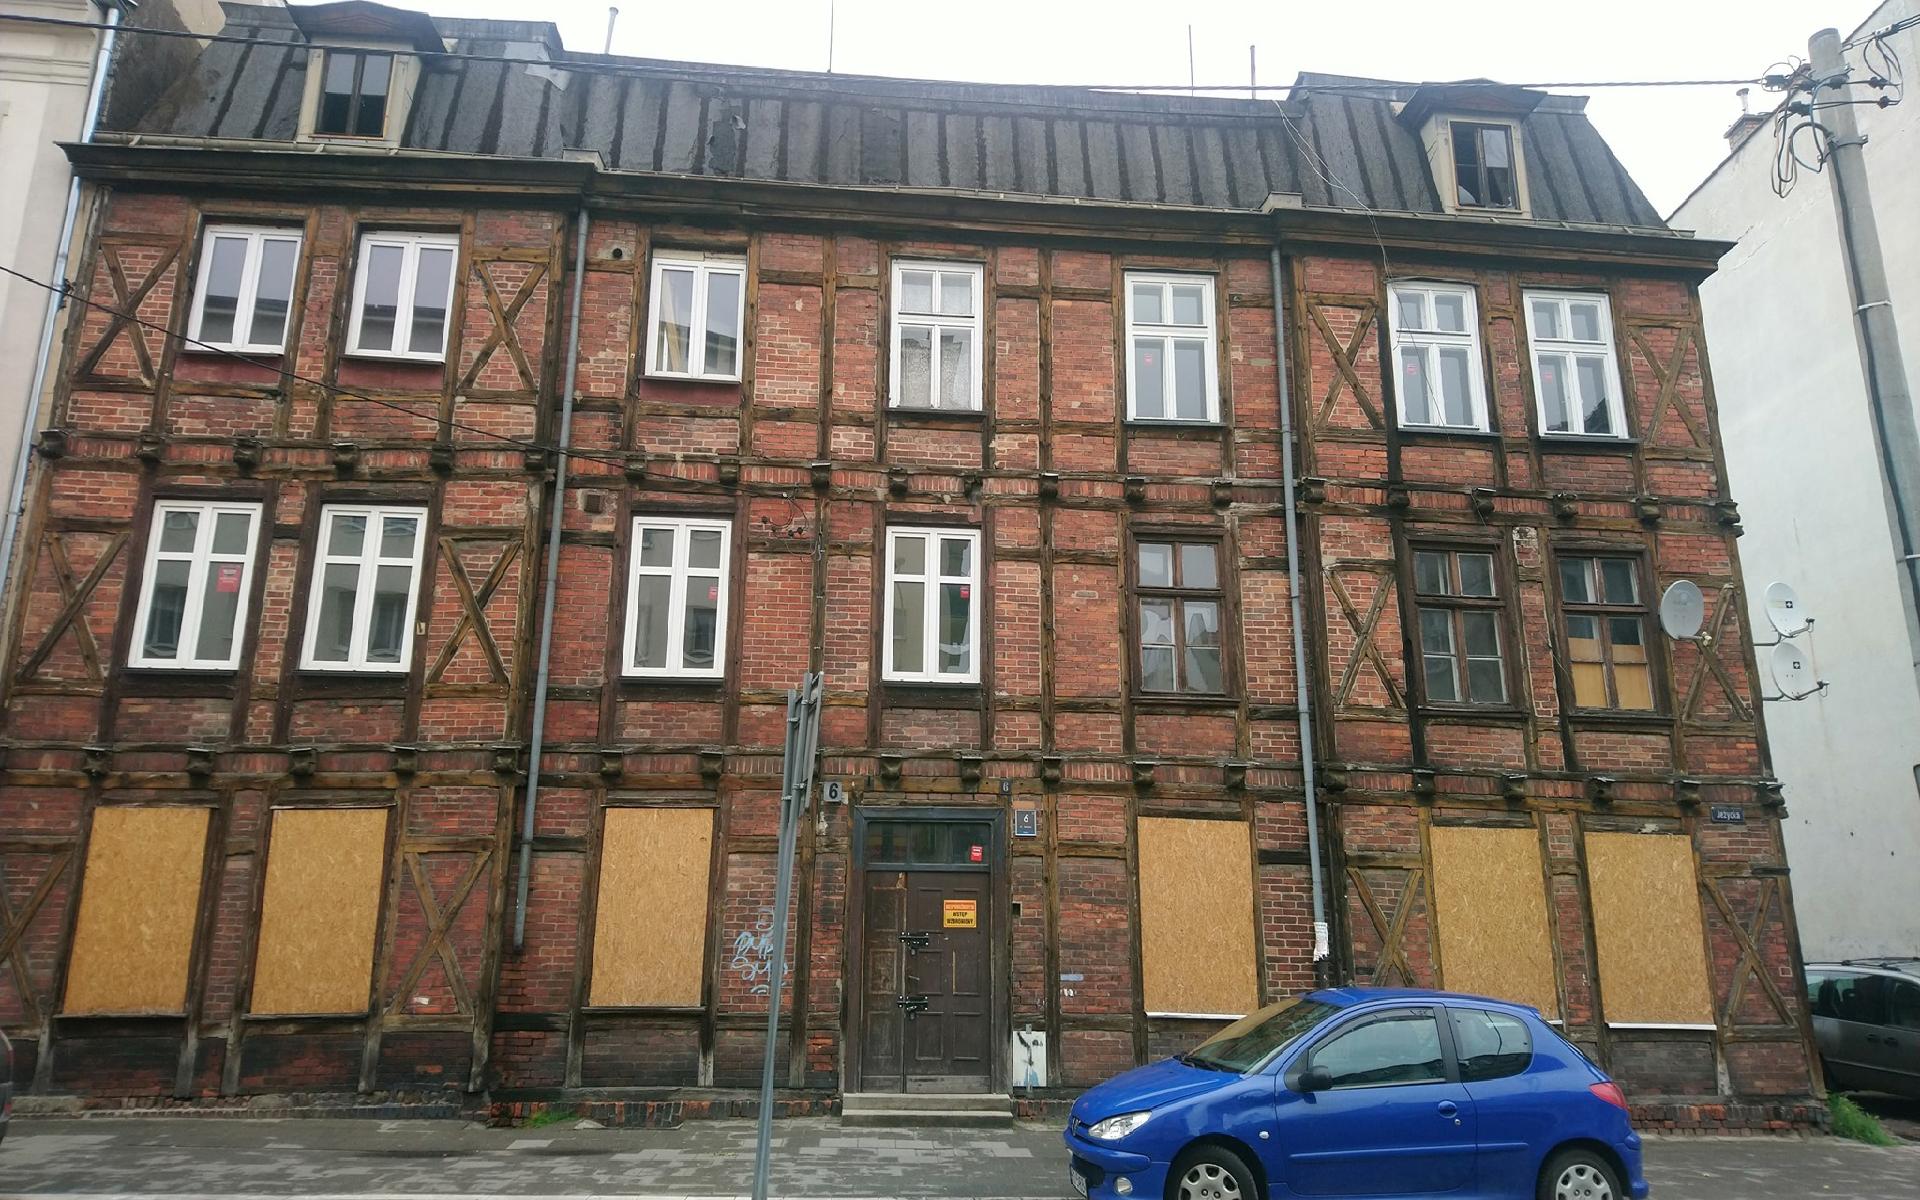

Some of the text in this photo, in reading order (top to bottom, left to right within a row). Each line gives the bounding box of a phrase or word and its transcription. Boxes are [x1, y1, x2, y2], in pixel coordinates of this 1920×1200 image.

[829, 782, 838, 799] 6
[1002, 781, 1009, 792] 6
[1023, 814, 1029, 823] 6
